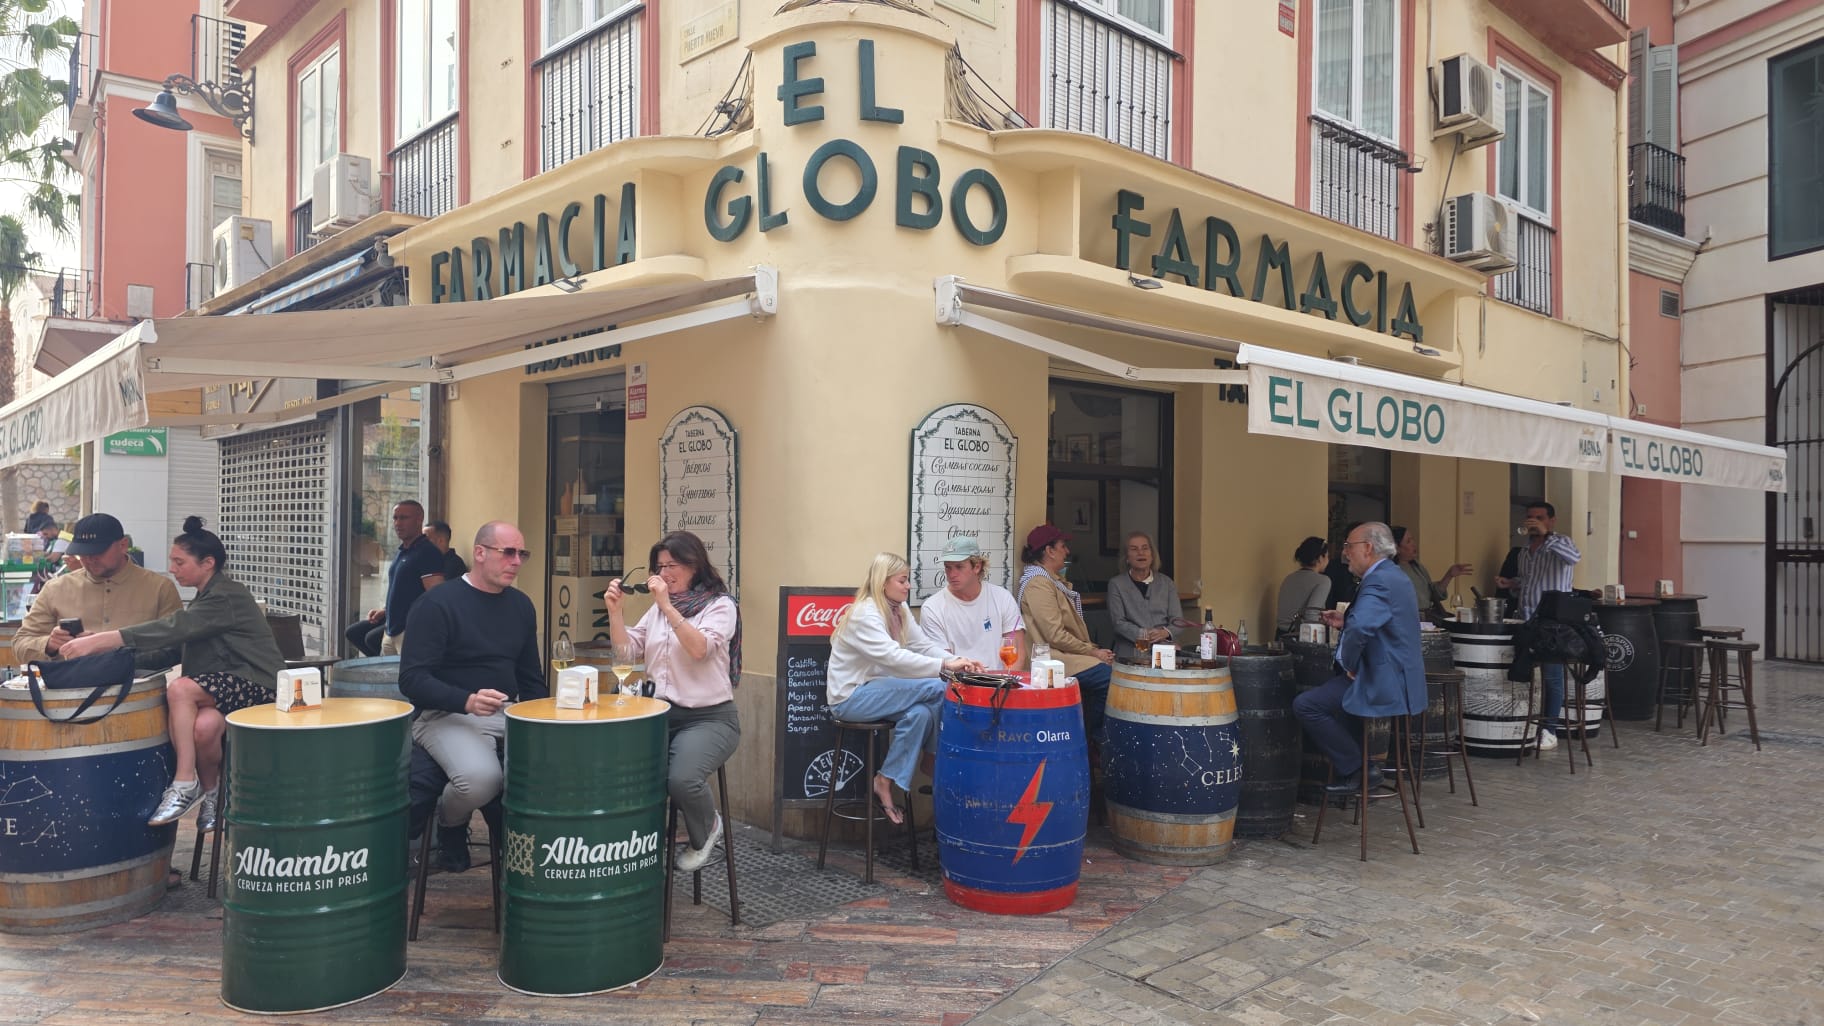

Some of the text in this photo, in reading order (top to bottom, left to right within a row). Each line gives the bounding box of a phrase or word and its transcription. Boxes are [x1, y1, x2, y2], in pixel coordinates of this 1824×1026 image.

[778, 39, 905, 126] EL
[705, 139, 1008, 246] GLOBO
[431, 182, 636, 304] FARMACIA
[1112, 189, 1423, 343] FARMACIA
[1214, 358, 1248, 405] TA
[1268, 376, 1445, 445] EL GLOBO
[9, 406, 43, 456] GLOBO
[110, 437, 144, 447] cudeca
[685, 428, 705, 438] TABERNA
[955, 427, 981, 437] TABERNA
[679, 439, 713, 453] EL GLOBO
[944, 438, 990, 452] EL GLOBO
[1620, 436, 1704, 477] EL GLOBO
[796, 602, 853, 628] Coca-C
[787, 704, 831, 714] Aperol Sp
[788, 691, 817, 704] Mojito
[787, 713, 827, 722] Manzanilla
[1036, 729, 1071, 743] Olarra
[235, 845, 369, 877] Alhambra
[539, 830, 658, 867] Alhambra
[544, 854, 658, 880] CERVEZA HECHA SIN PRISA
[237, 872, 368, 893] CERVEZA HECHA SIN PRISA
